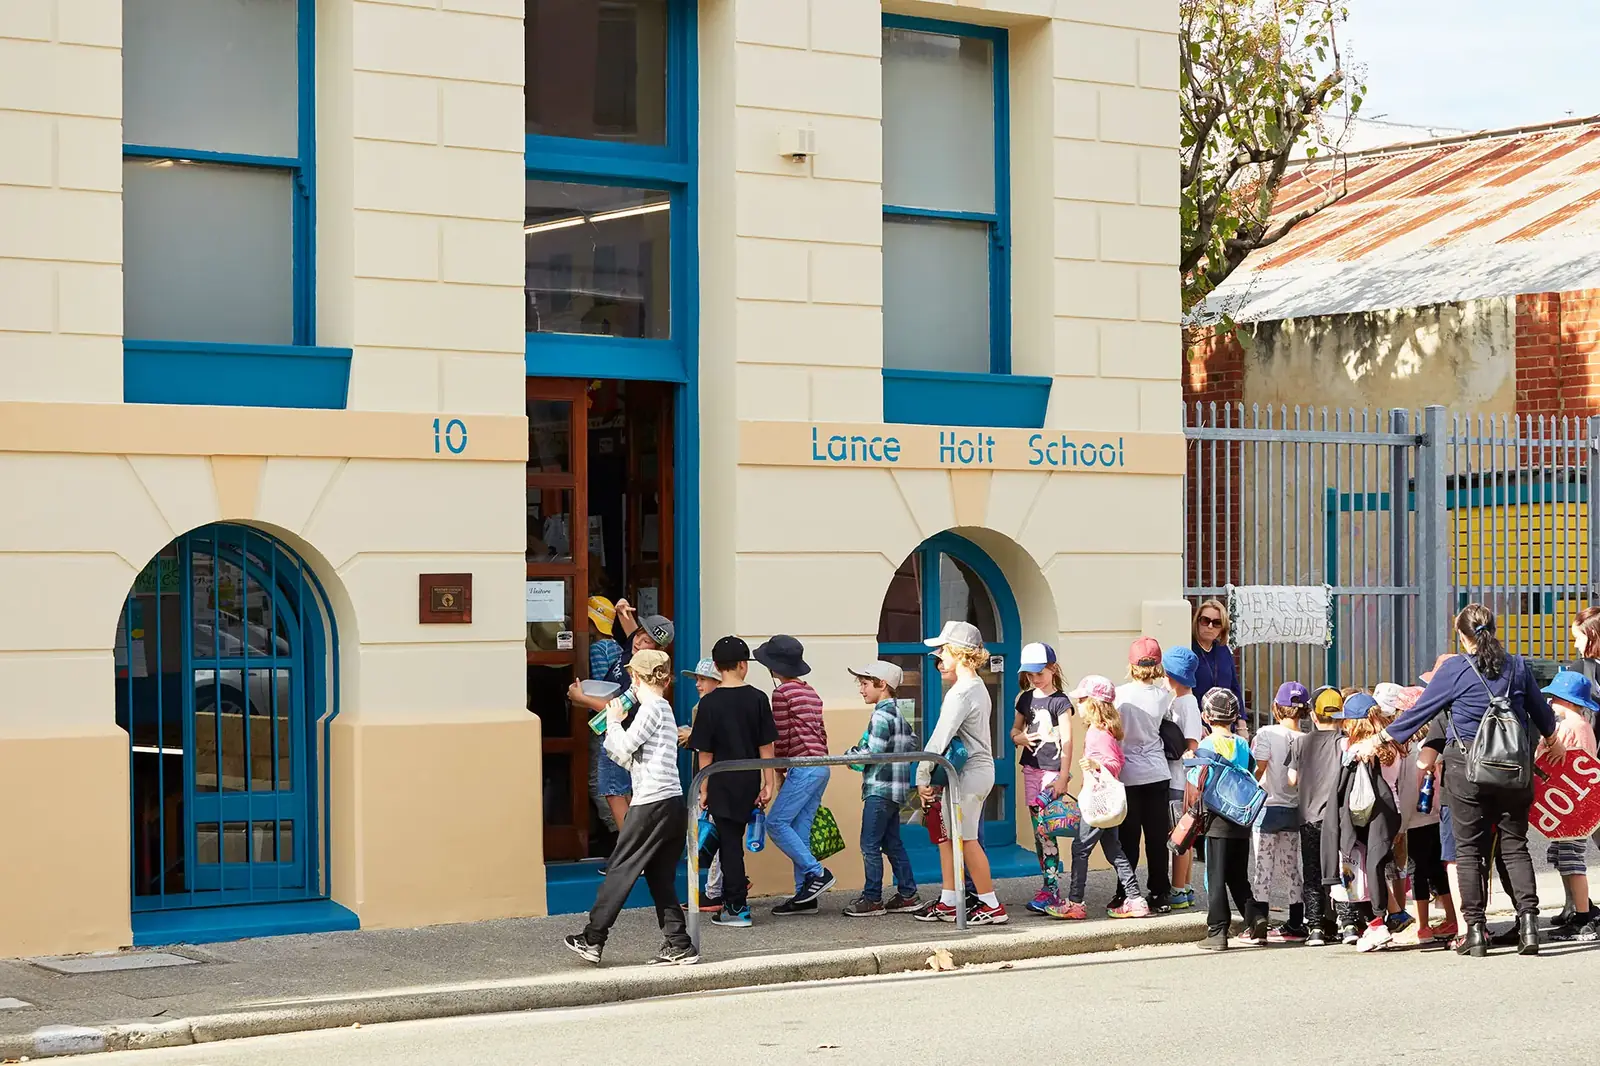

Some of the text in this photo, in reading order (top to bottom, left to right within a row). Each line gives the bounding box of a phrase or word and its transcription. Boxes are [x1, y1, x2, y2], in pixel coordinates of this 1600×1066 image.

[432, 418, 468, 454] 10
[812, 427, 1125, 467] Lance Holt School
[1239, 592, 1288, 613] HERE
[1240, 616, 1324, 638] DRAGONS
[1533, 755, 1600, 832] STOP
